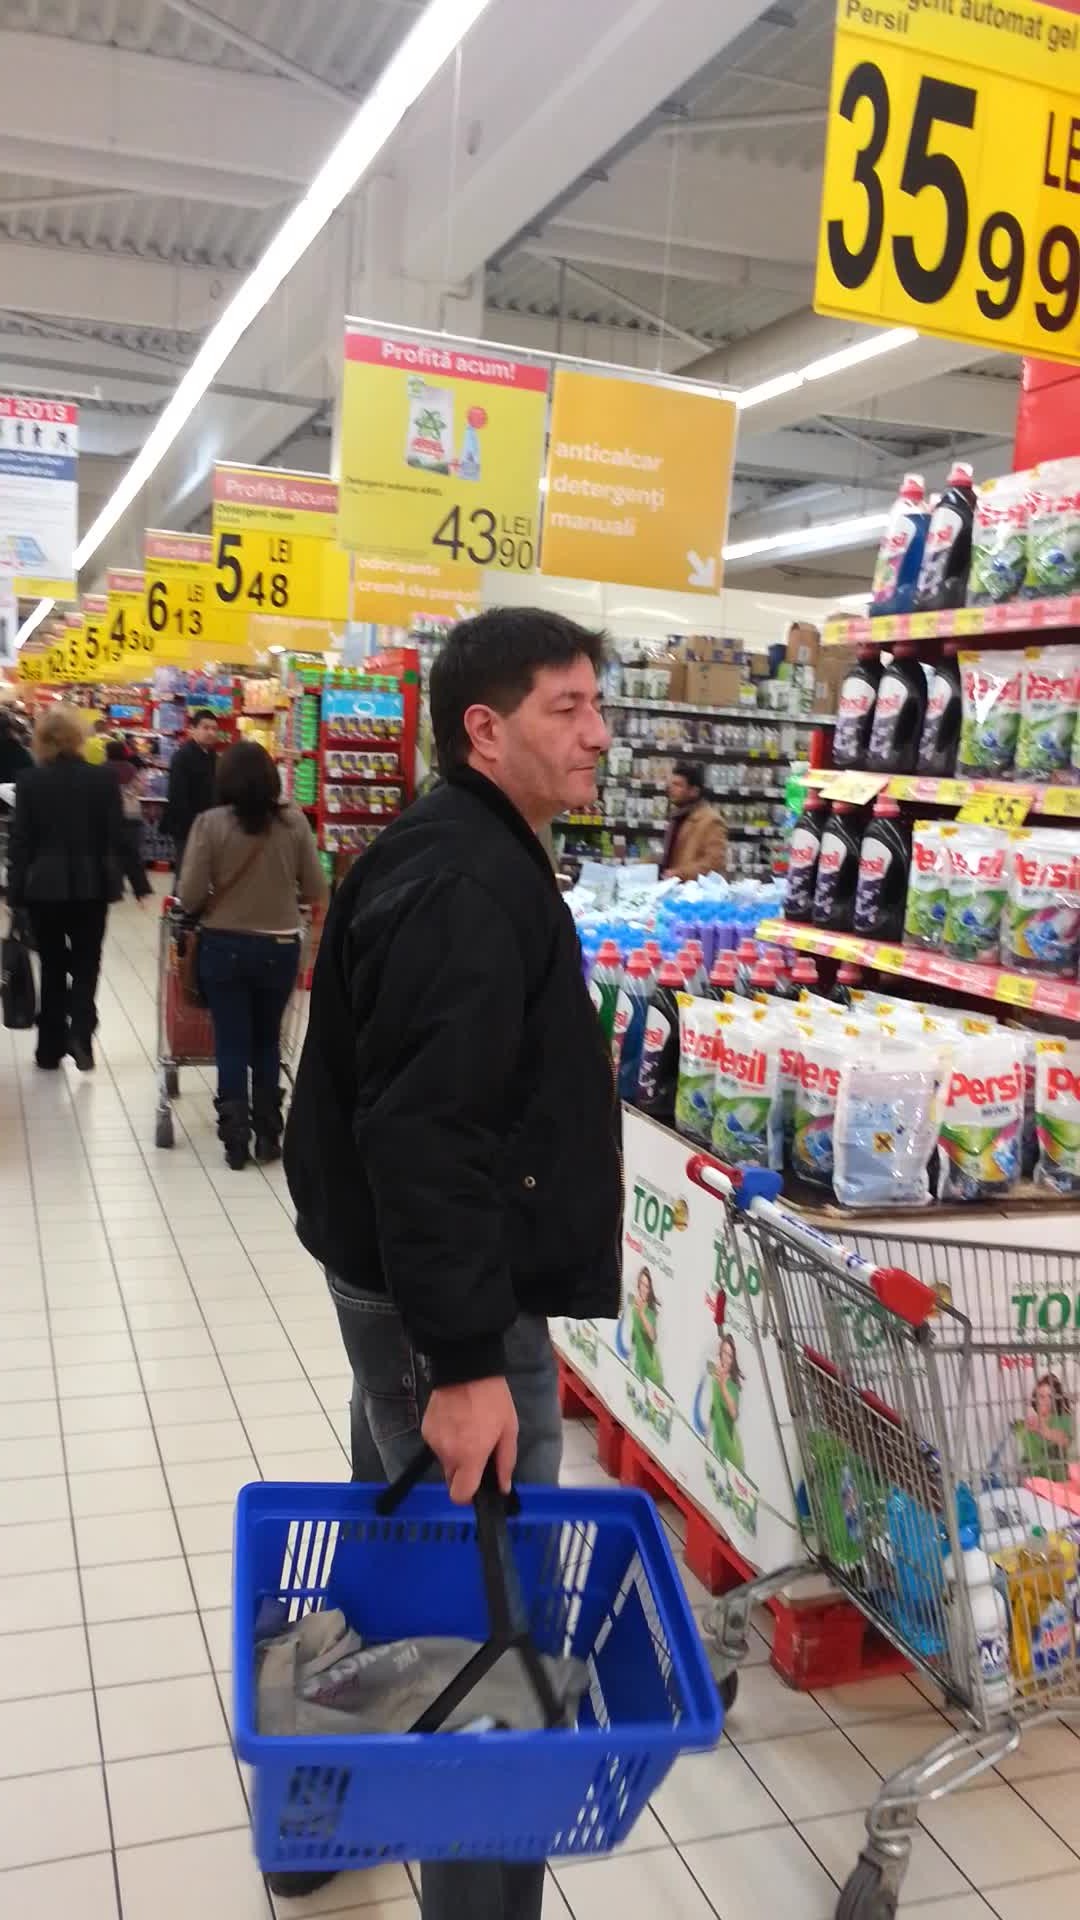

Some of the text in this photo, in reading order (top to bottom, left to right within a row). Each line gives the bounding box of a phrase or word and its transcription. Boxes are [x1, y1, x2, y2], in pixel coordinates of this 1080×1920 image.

[845, 0, 909, 33] Persil
[961, 0, 1042, 40] automat
[1047, 21, 1077, 52] gel
[1043, 111, 1080, 195] LE
[827, 61, 1080, 332] 35 99
[454, 356, 516, 381] acum!
[553, 441, 664, 472] anticalcar
[432, 504, 533, 570] 43 90
[501, 514, 531, 537] LEI
[550, 512, 636, 537] manuali
[215, 532, 289, 608] 5 48
[110, 608, 126, 650] 4
[148, 581, 168, 632] 6
[174, 608, 204, 636] 13
[633, 1184, 677, 1242] TOP
[1011, 1292, 1080, 1336] TO
